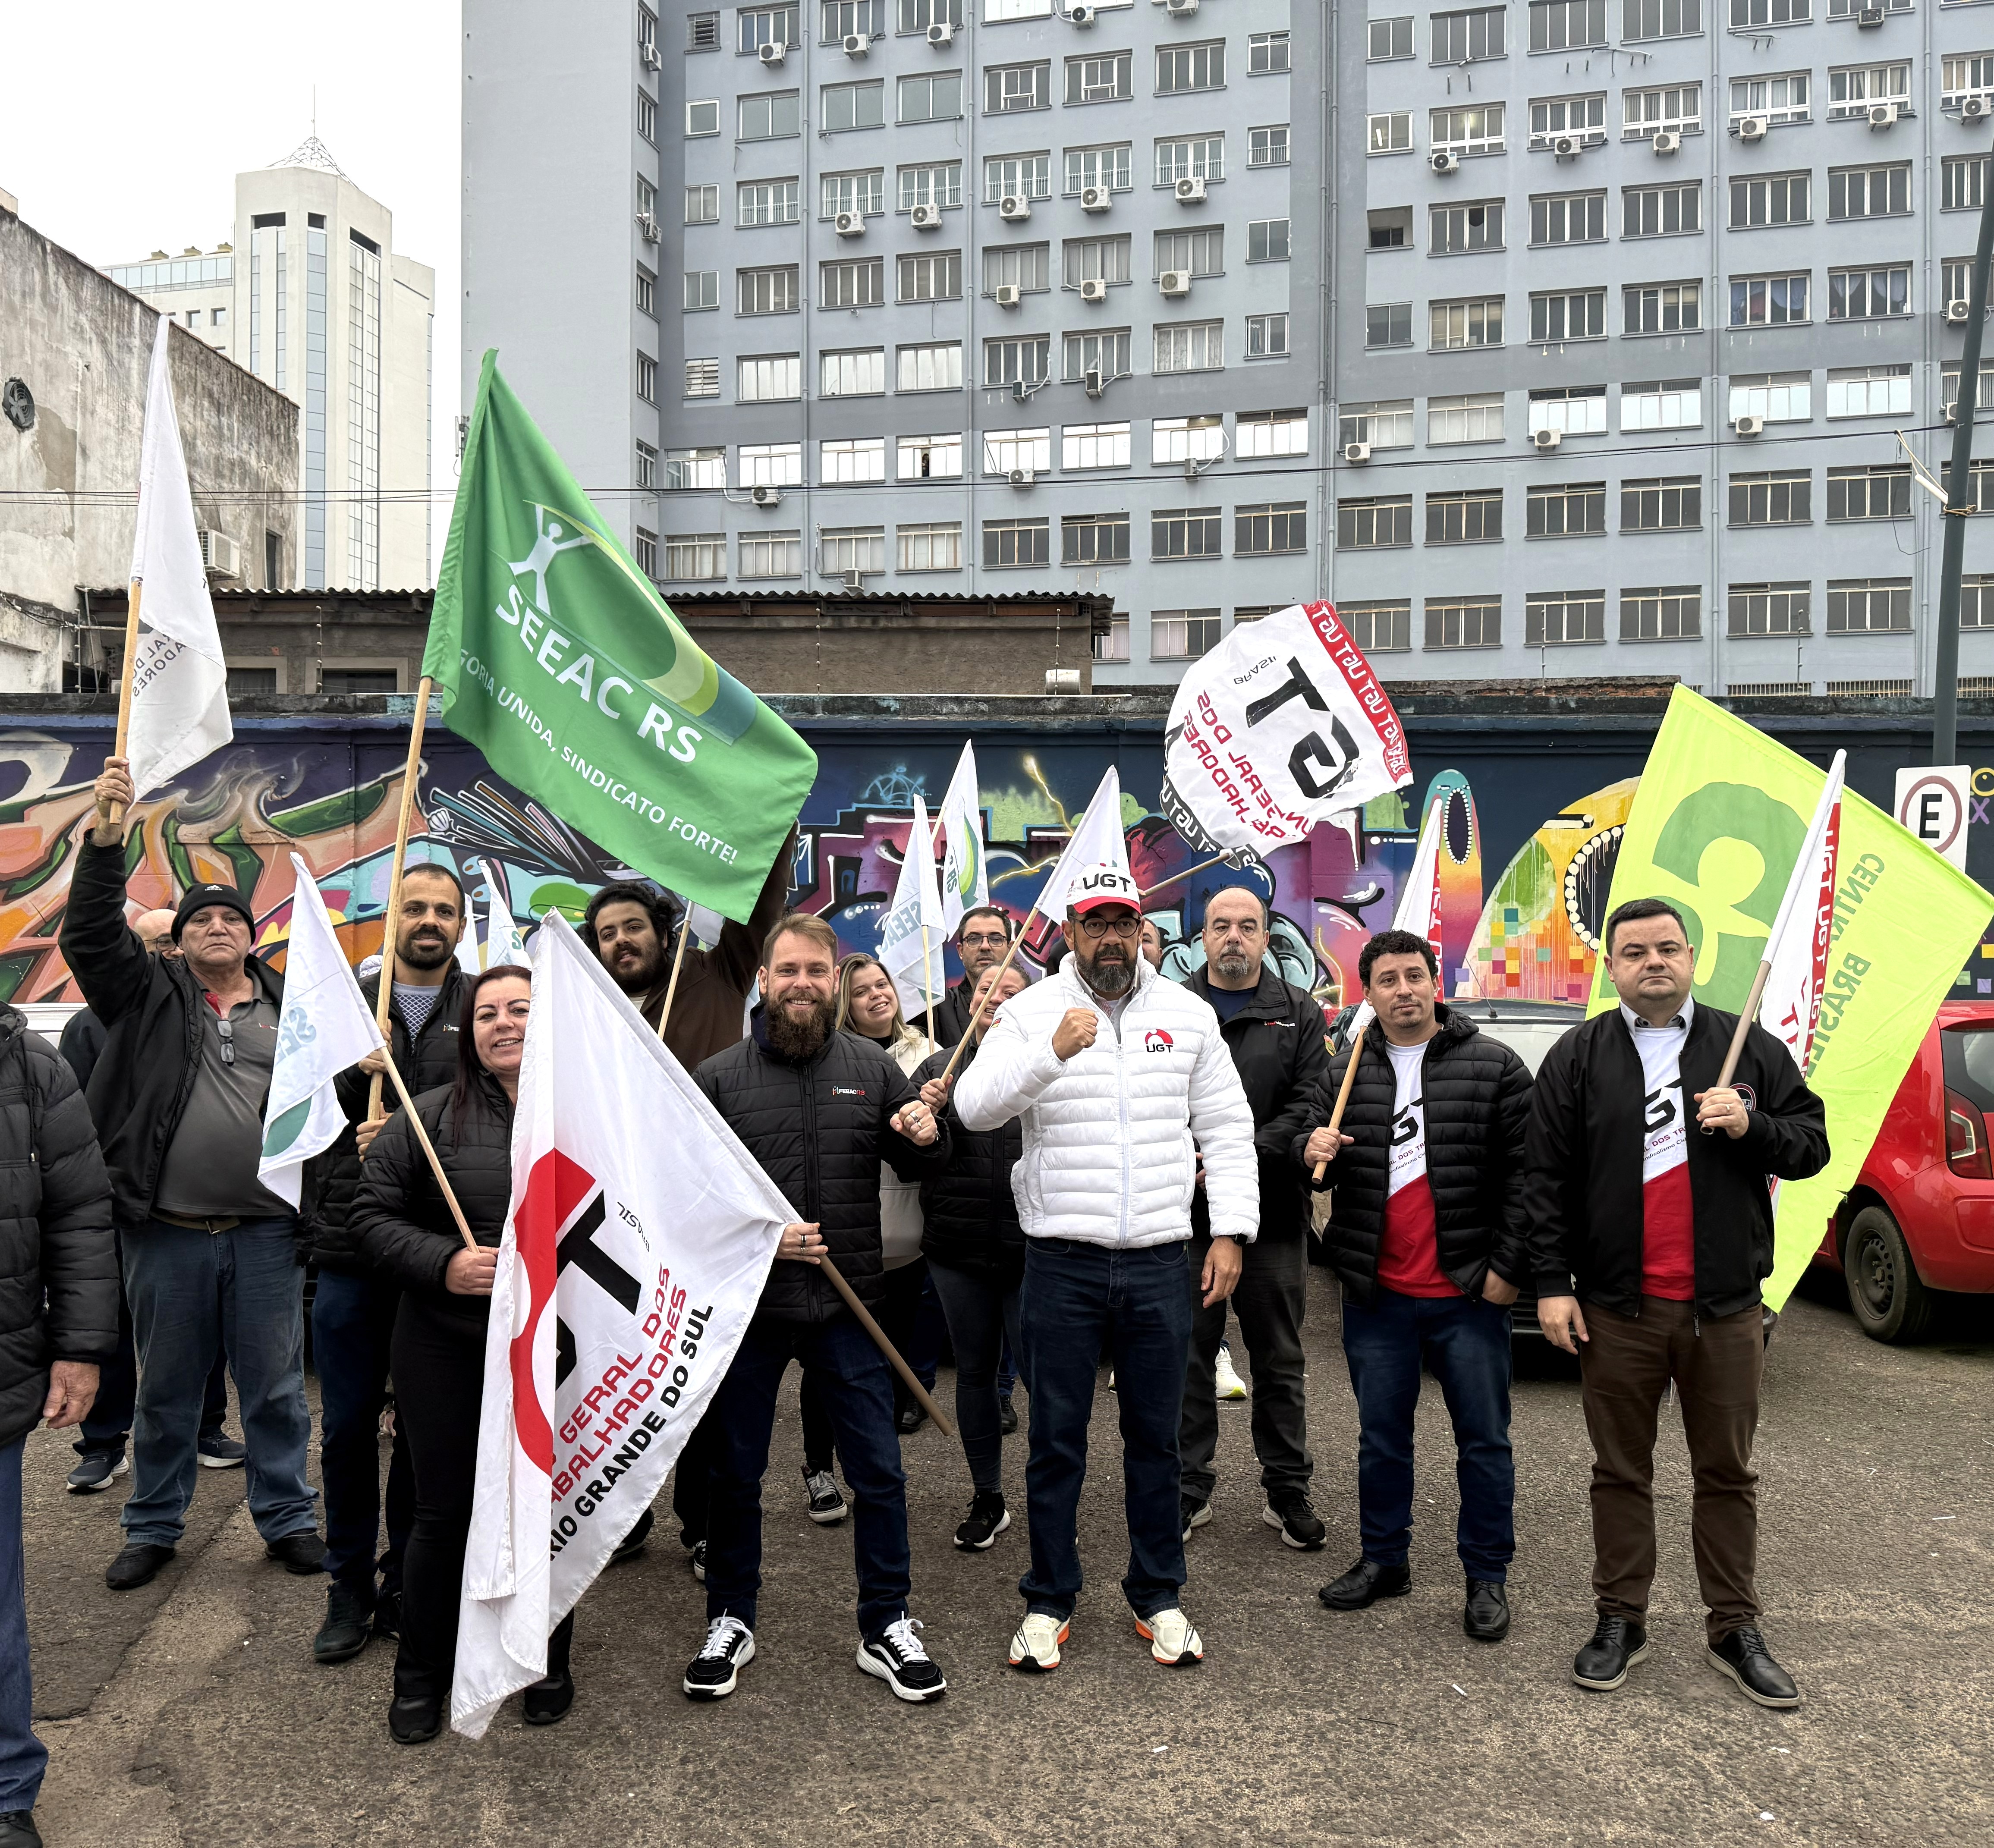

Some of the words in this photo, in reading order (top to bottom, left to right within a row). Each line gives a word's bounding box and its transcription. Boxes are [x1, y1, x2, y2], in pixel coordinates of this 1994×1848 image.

[495, 584, 633, 719] SEEAC
[637, 702, 702, 763] RS
[497, 686, 558, 753] UNIDA,
[561, 746, 665, 824] SINDICATO
[668, 816, 738, 865] FORTE!
[1919, 793, 1942, 839] E
[1083, 873, 1131, 892] UGT
[1815, 904, 1830, 967] UGT
[1146, 1043, 1173, 1053] UGT
[1398, 1149, 1413, 1160] DOS
[1652, 1135, 1670, 1147] DOS
[559, 1352, 643, 1444] GERAL
[642, 1262, 670, 1339] DOS
[575, 1410, 667, 1517] GRANDE
[660, 1365, 688, 1409] DO
[680, 1305, 713, 1360] SUL
